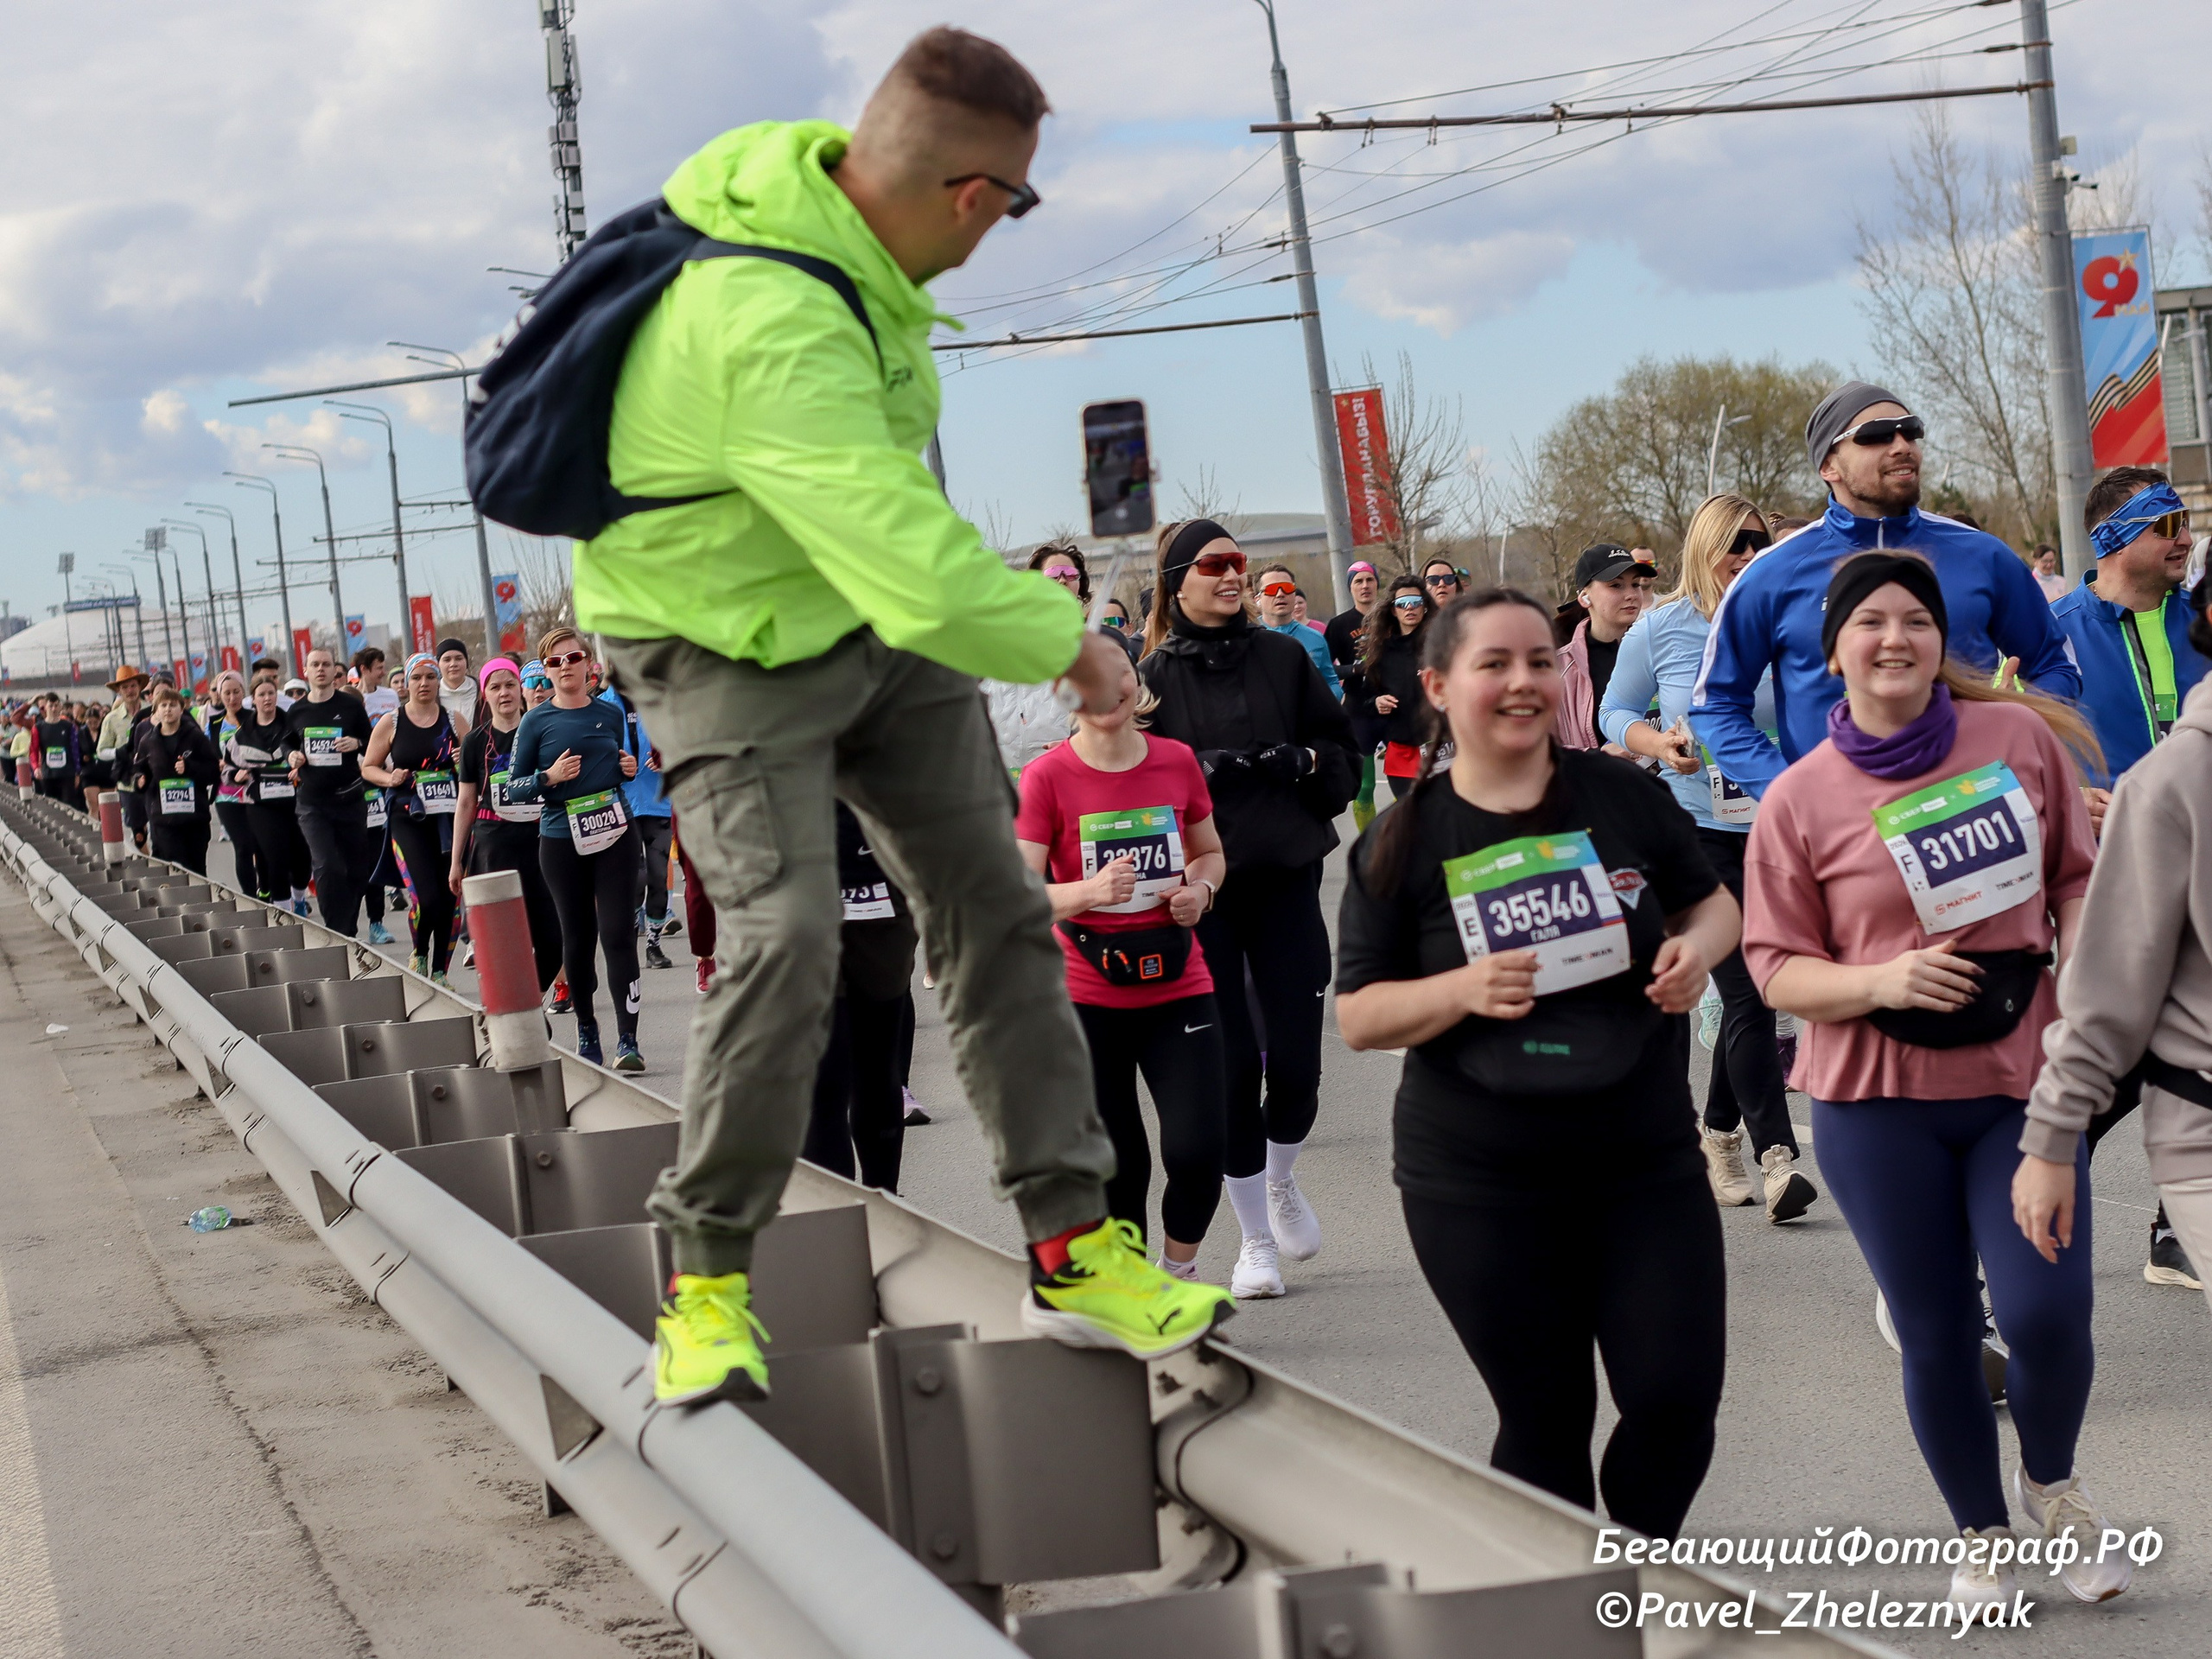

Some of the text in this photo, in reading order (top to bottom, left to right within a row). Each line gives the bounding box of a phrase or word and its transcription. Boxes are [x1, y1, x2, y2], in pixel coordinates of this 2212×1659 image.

[2082, 254, 2139, 320] 9
[495, 581, 516, 604] 9
[1713, 778, 1720, 789] F
[572, 823, 577, 831] F
[581, 810, 616, 831] 30028
[1921, 810, 2015, 870] 31701
[1086, 858, 1094, 870] F
[1901, 854, 1914, 874] F
[1488, 880, 1592, 938] 35546
[1947, 891, 1983, 911] МАГНИТ
[1465, 918, 1478, 937] E
